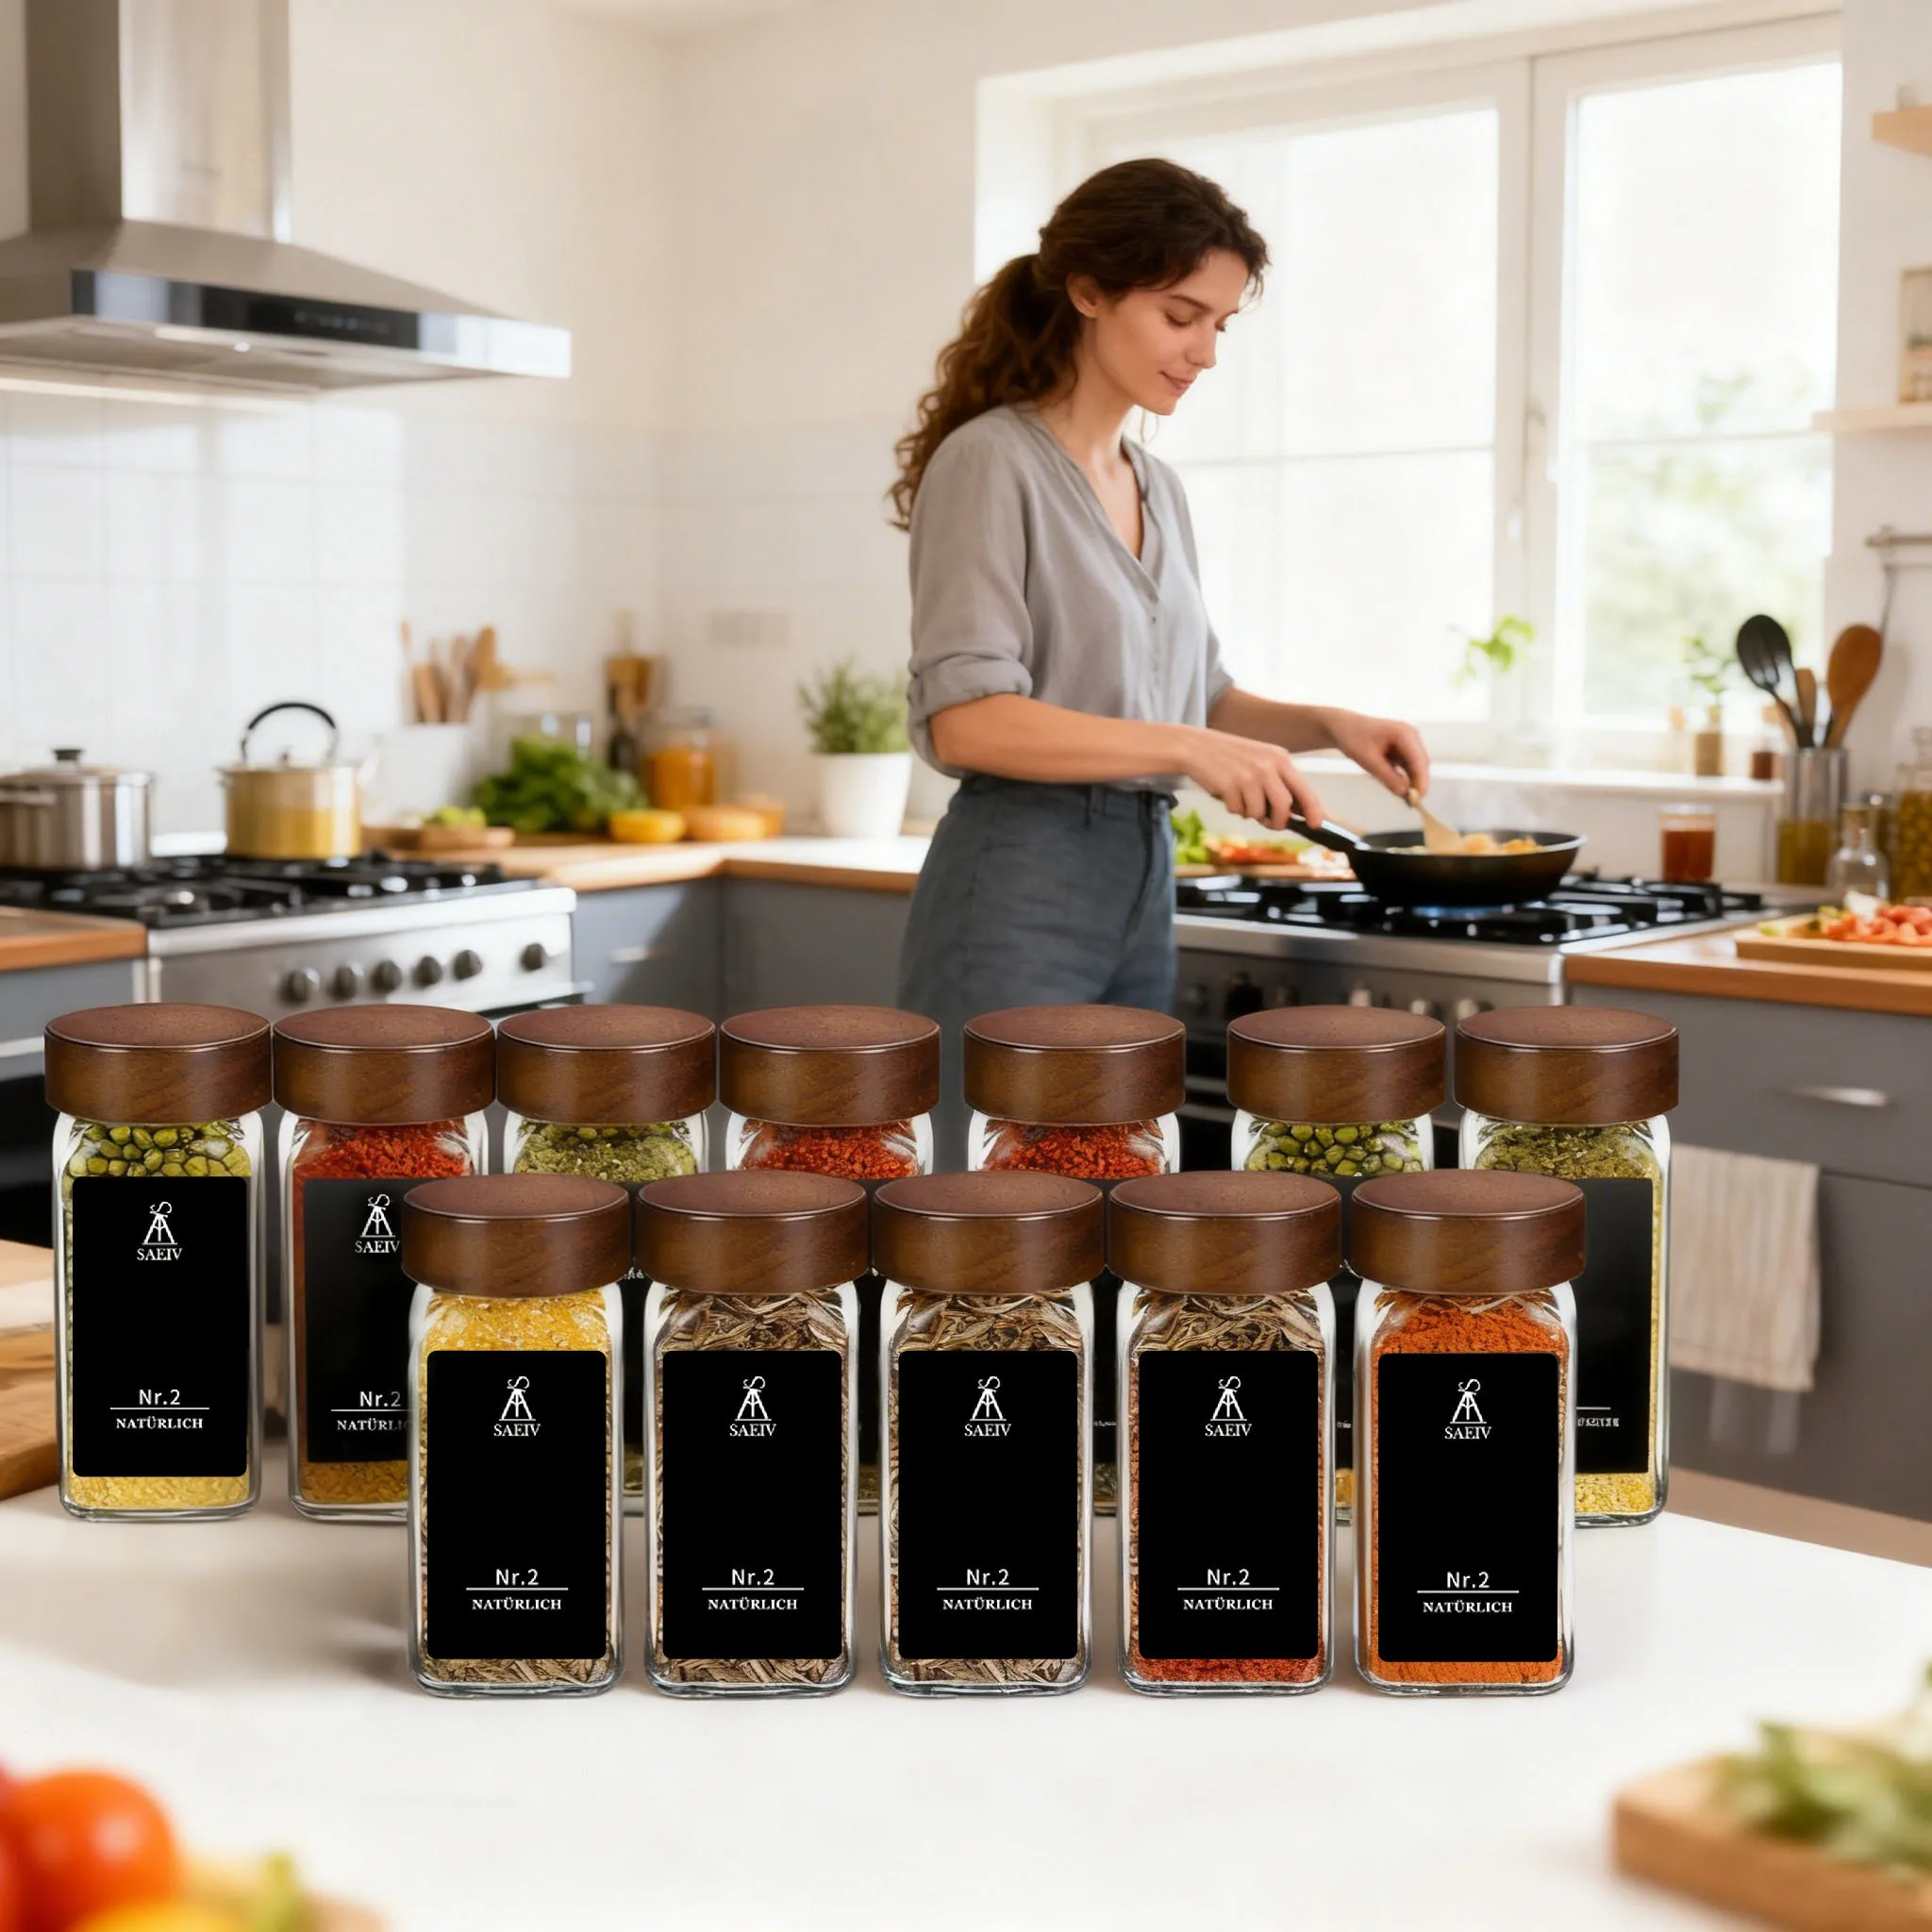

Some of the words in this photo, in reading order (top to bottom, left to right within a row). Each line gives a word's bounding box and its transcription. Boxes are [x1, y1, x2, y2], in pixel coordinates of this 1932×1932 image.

[355, 1241, 400, 1253] SAEIV
[137, 1248, 182, 1261] SAEIV
[140, 1390, 181, 1405] Nr.2
[360, 1391, 401, 1407] Nr.2
[116, 1415, 204, 1429] NATÜRLICH
[494, 1424, 541, 1437] SAEIV
[730, 1424, 776, 1437] SAEIV
[965, 1424, 1011, 1437] SAEIV
[1206, 1424, 1252, 1437] SAEIV
[1445, 1426, 1491, 1440] SAEIV
[495, 1568, 539, 1585] Nr.2
[731, 1568, 774, 1585] Nr.2
[967, 1568, 1010, 1585] Nr.2
[1208, 1568, 1251, 1585] Nr.2
[1447, 1572, 1491, 1589] Nr.2
[473, 1596, 562, 1610] NATÜRLICH
[708, 1596, 798, 1610] NATÜRLICH
[943, 1596, 1033, 1610] NATÜRLICH
[1184, 1596, 1274, 1610] NATÜRLICH
[1424, 1599, 1513, 1613] NATÜRLICH
